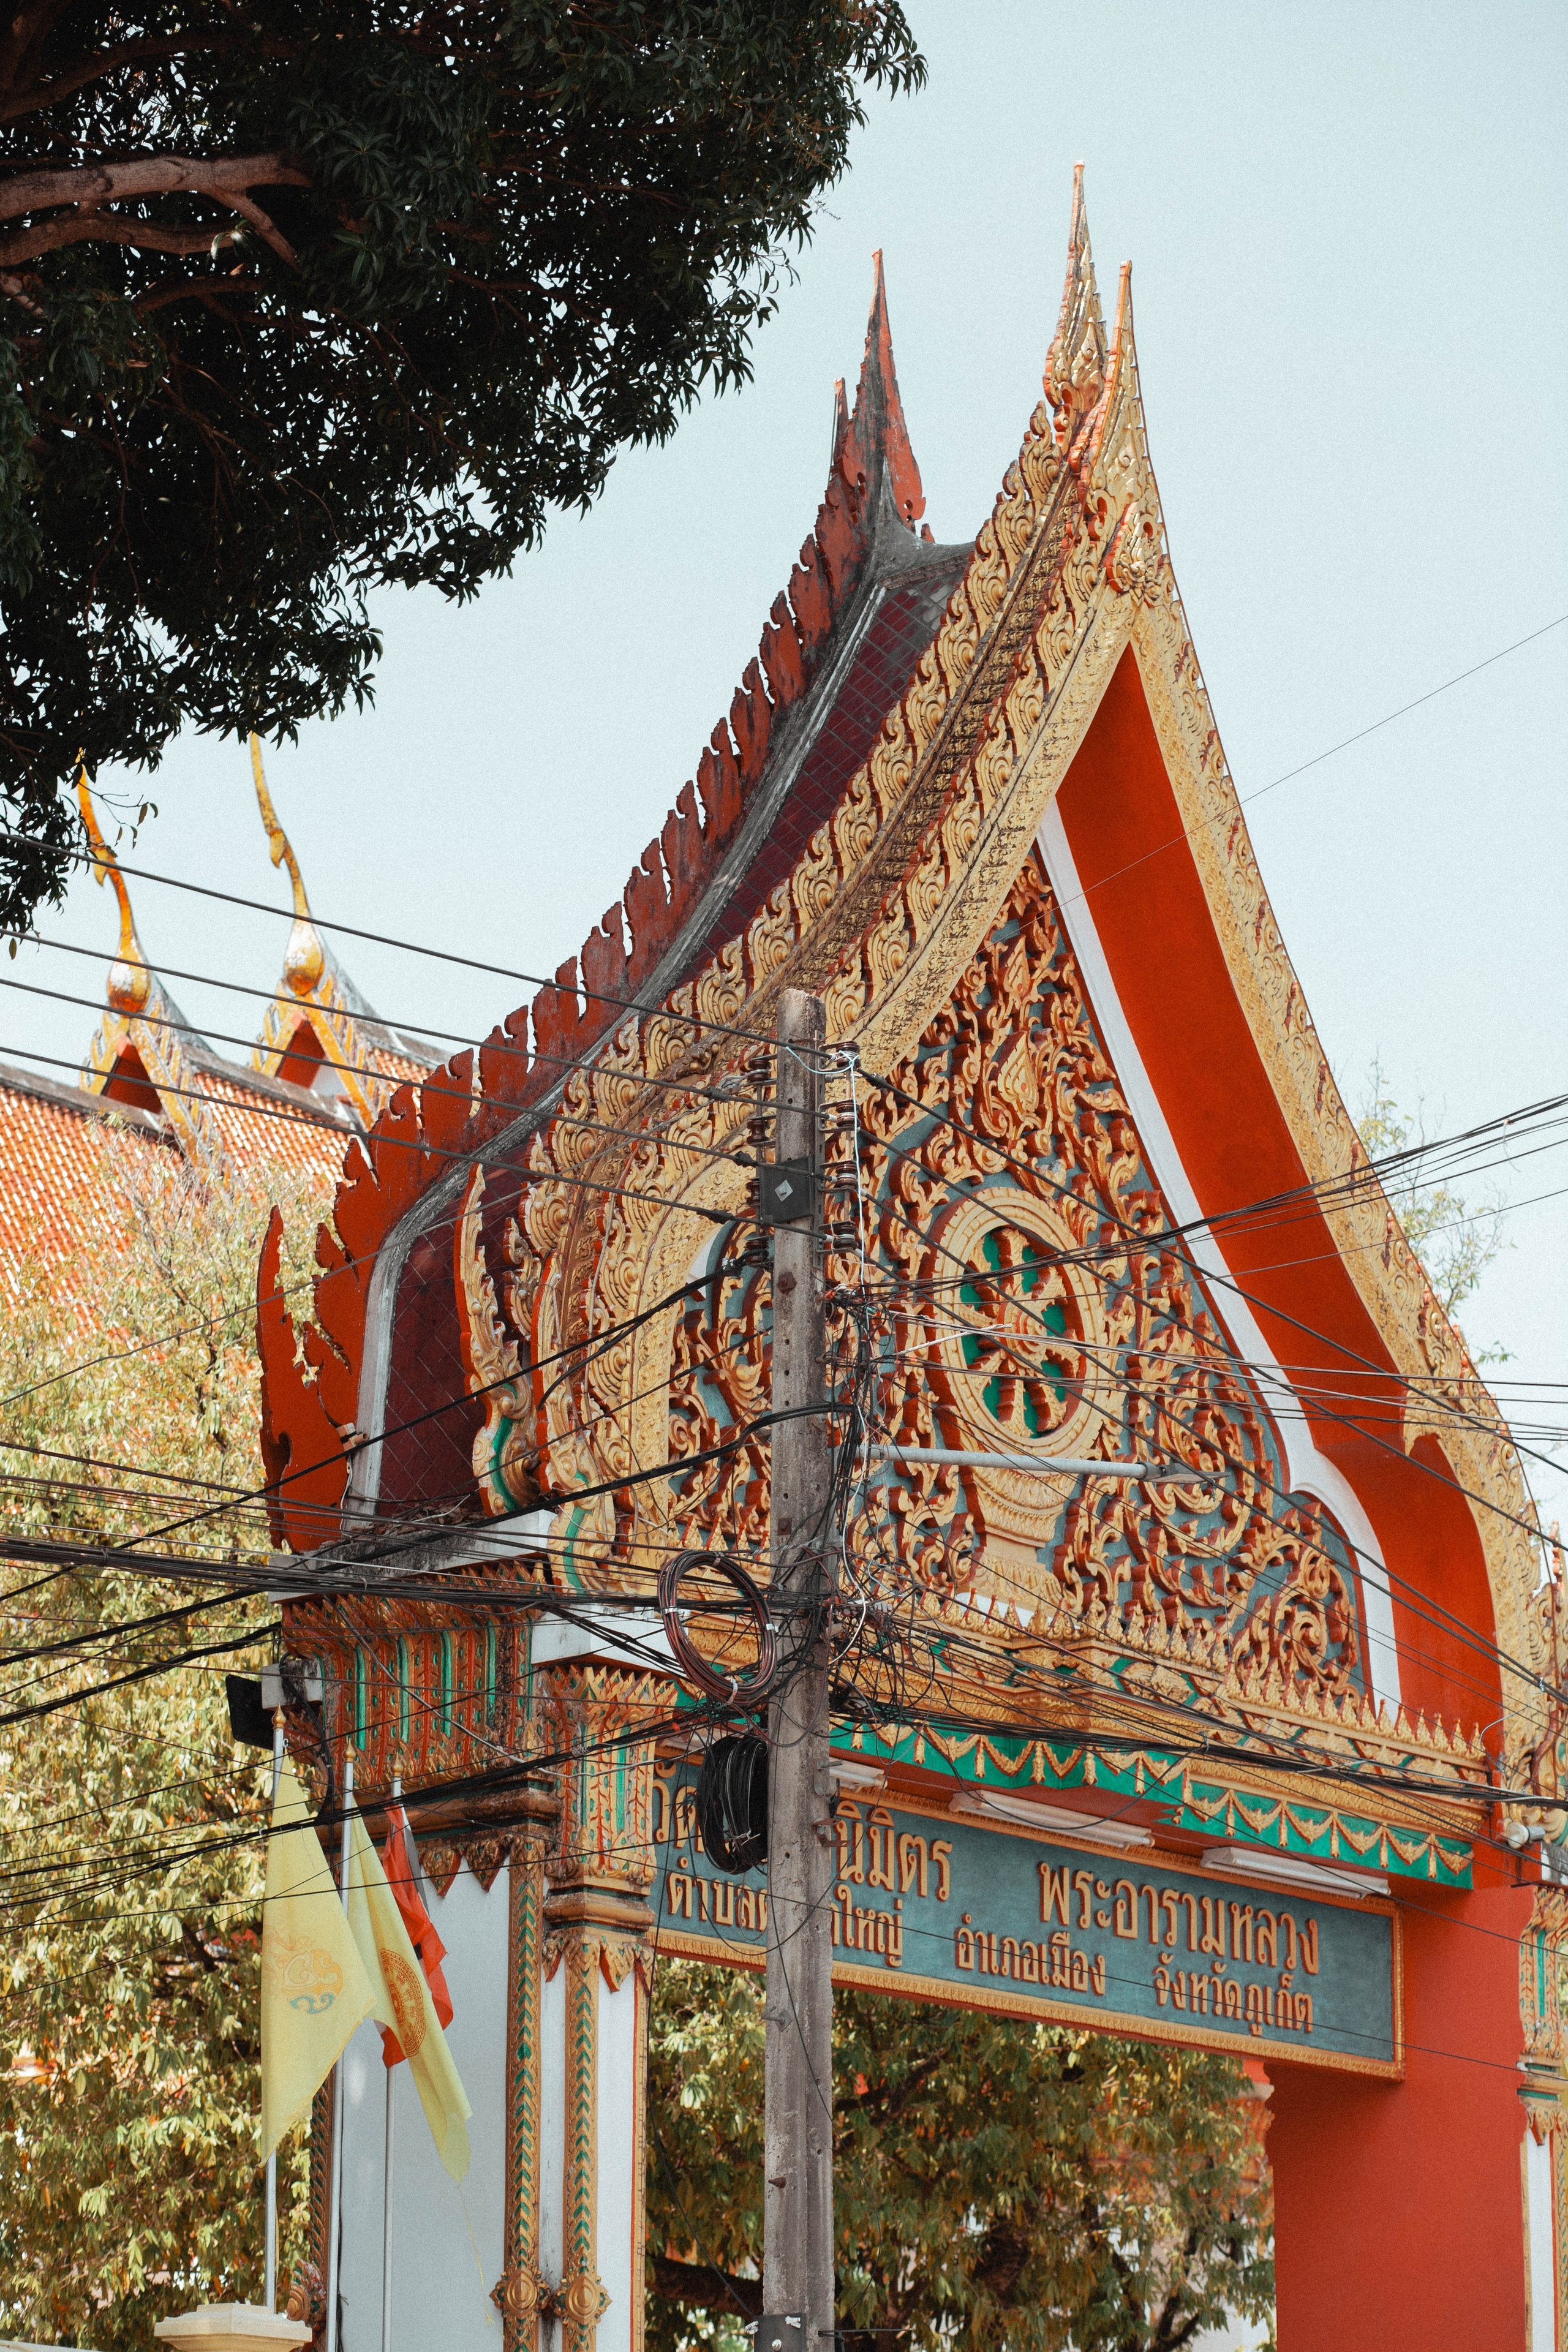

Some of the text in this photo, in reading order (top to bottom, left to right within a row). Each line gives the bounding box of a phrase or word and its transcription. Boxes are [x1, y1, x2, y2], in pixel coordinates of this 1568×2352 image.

[954, 1913, 1105, 1996] อำเภอเมือง
[1153, 1952, 1313, 2036] จังหวัดภูเก็ต
[1038, 1861, 1319, 1975] พระอารามหลวง
